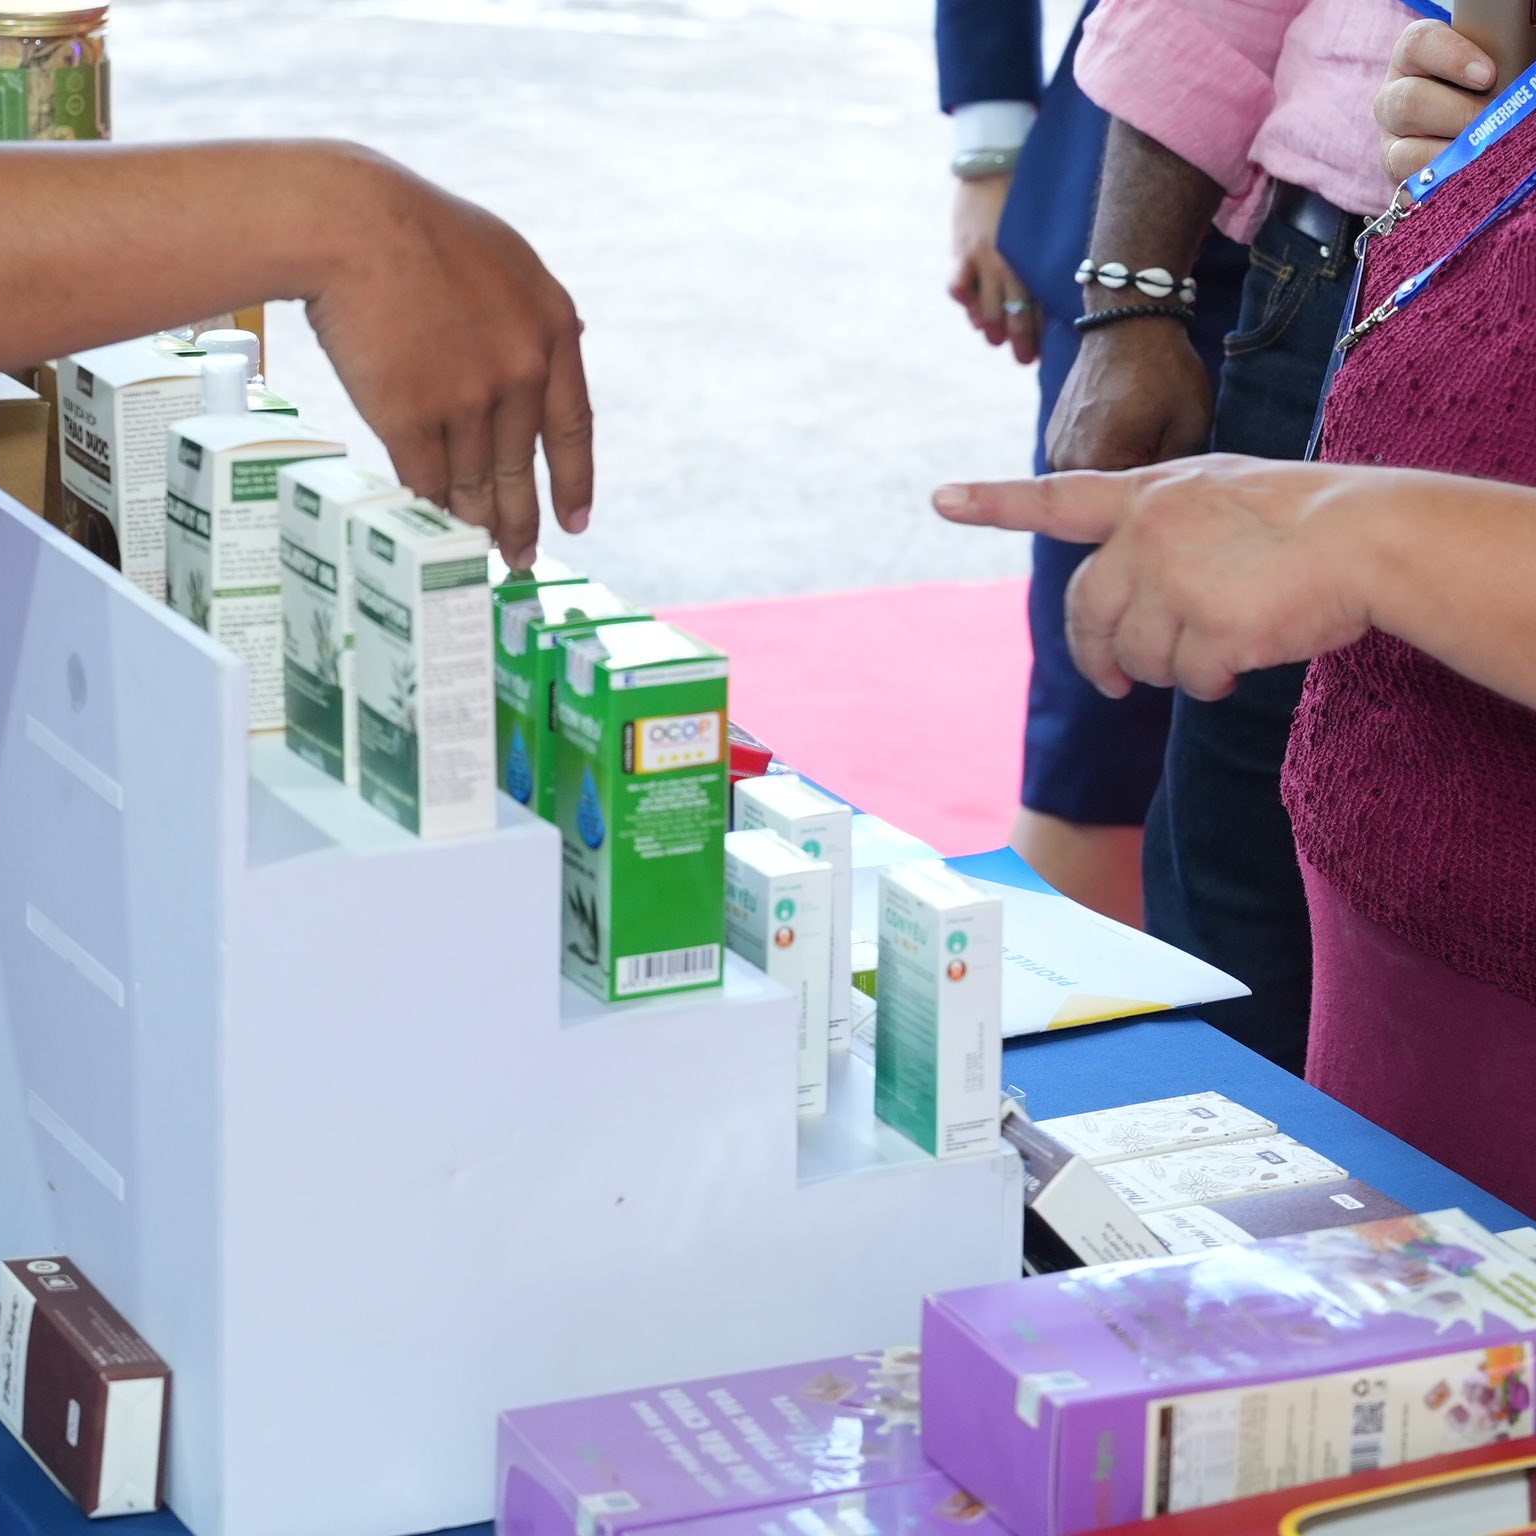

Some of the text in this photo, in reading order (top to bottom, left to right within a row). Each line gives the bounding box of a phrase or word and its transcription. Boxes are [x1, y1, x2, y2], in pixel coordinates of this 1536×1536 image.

[1468, 84, 1534, 147] CONFERENCE
[649, 719, 711, 739] OCOP
[1004, 953, 1079, 987] PROFILE
